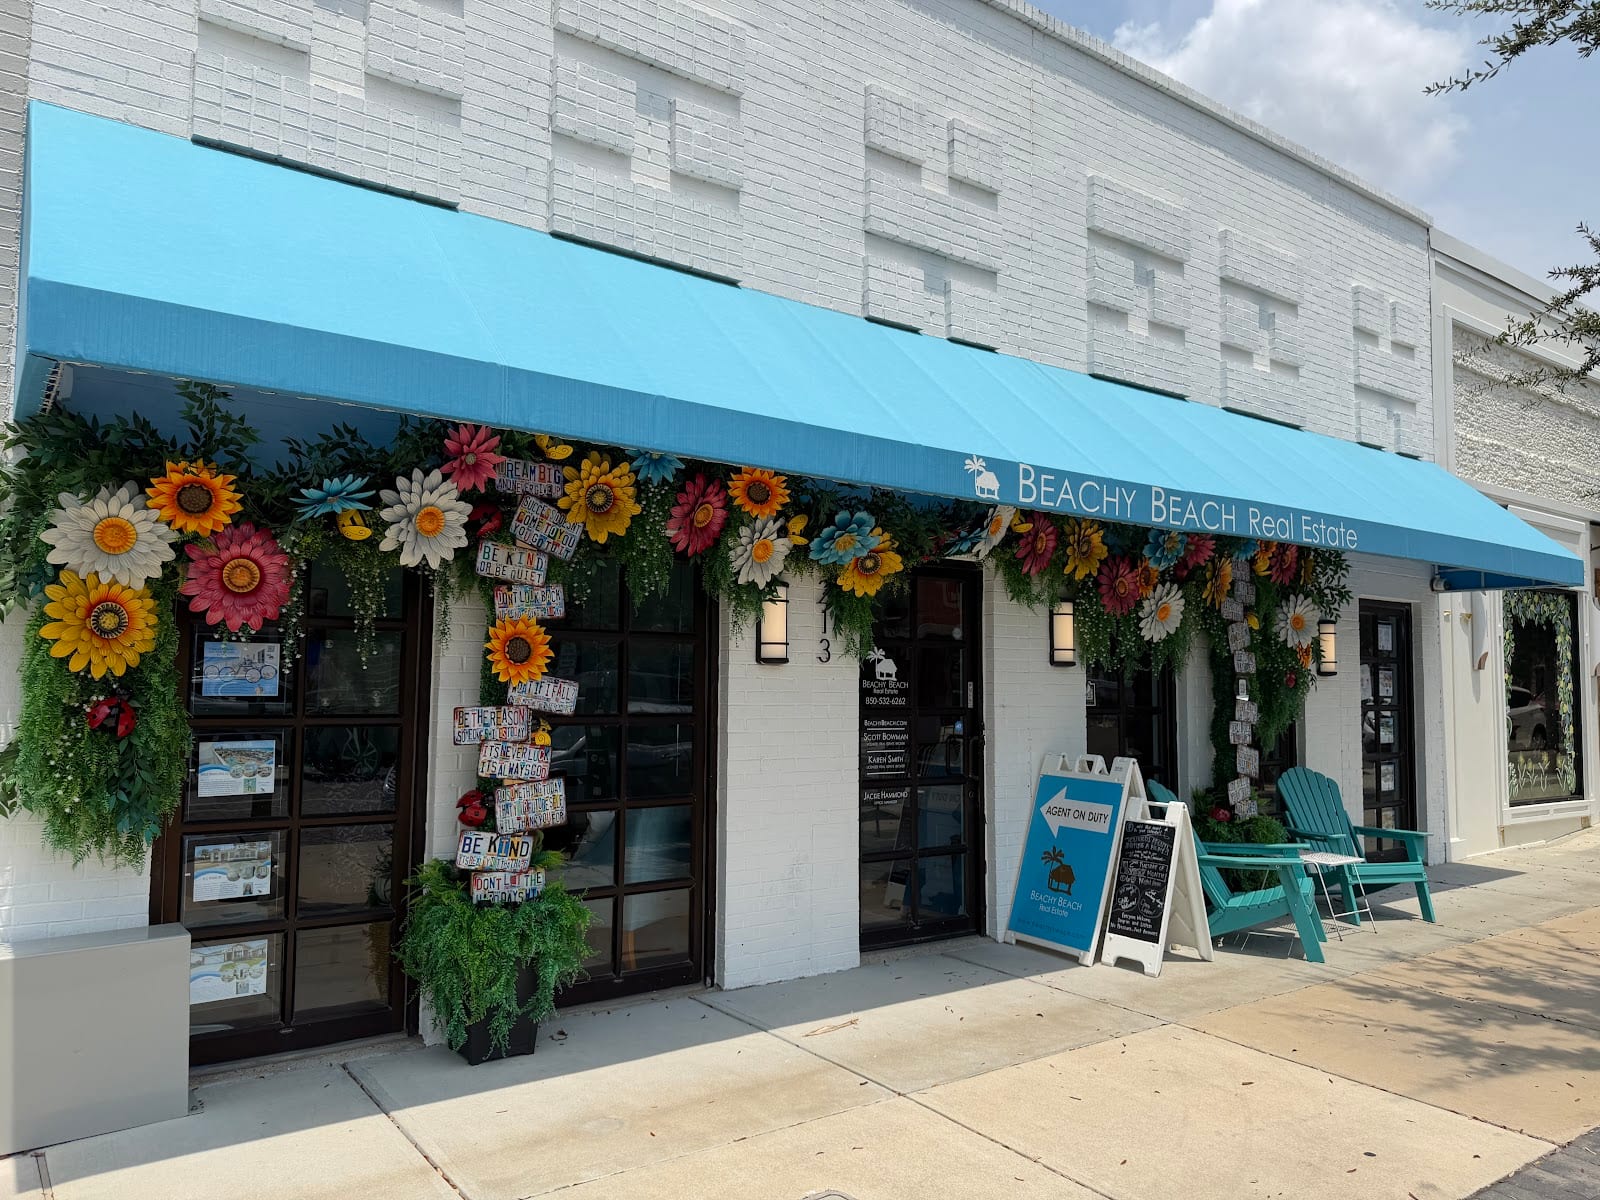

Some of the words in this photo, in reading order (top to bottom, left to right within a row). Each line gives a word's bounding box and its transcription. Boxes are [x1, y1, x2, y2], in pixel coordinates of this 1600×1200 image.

[497, 461, 536, 481] DREAM
[538, 464, 562, 484] BIG
[1018, 463, 1136, 517] BEACHY
[1151, 486, 1235, 532] BEACH
[1248, 507, 1294, 540] Real
[1301, 515, 1358, 548] Estate
[516, 510, 544, 532] COME
[544, 522, 558, 539] TO
[558, 529, 575, 548] YOU
[513, 523, 531, 540] YOU
[532, 534, 546, 548] GO
[545, 540, 557, 553] TO
[558, 546, 571, 560] IT
[482, 545, 499, 562] BE
[506, 550, 544, 571] KIND
[479, 560, 491, 575] OR
[495, 565, 507, 576] BE
[510, 568, 542, 584] QUIET
[862, 680, 887, 688] BEACHY
[865, 697, 906, 705] 850-532-6262
[458, 710, 470, 729] BE
[472, 709, 490, 728] THE
[490, 706, 525, 726] REASON
[863, 732, 881, 741] SCOTT
[482, 745, 499, 759] ITS
[501, 745, 527, 760] NEVER
[528, 747, 550, 763] LUCK
[868, 755, 887, 764] KAREN
[887, 755, 904, 763] SMITH
[480, 761, 497, 774] ITS
[498, 762, 530, 777] ALWAYS
[530, 764, 547, 779] GOD
[1046, 806, 1071, 818] AGENT
[1073, 810, 1086, 821] ON
[1088, 812, 1109, 824] DUTY
[462, 837, 483, 854] BE
[488, 836, 530, 858] KIND
[477, 878, 501, 890] DONT
[524, 871, 542, 885] THE
[1030, 890, 1058, 905] BEACHY
[1058, 896, 1083, 911] BEACH
[1039, 903, 1051, 912] Real
[1051, 906, 1069, 918] Estate
